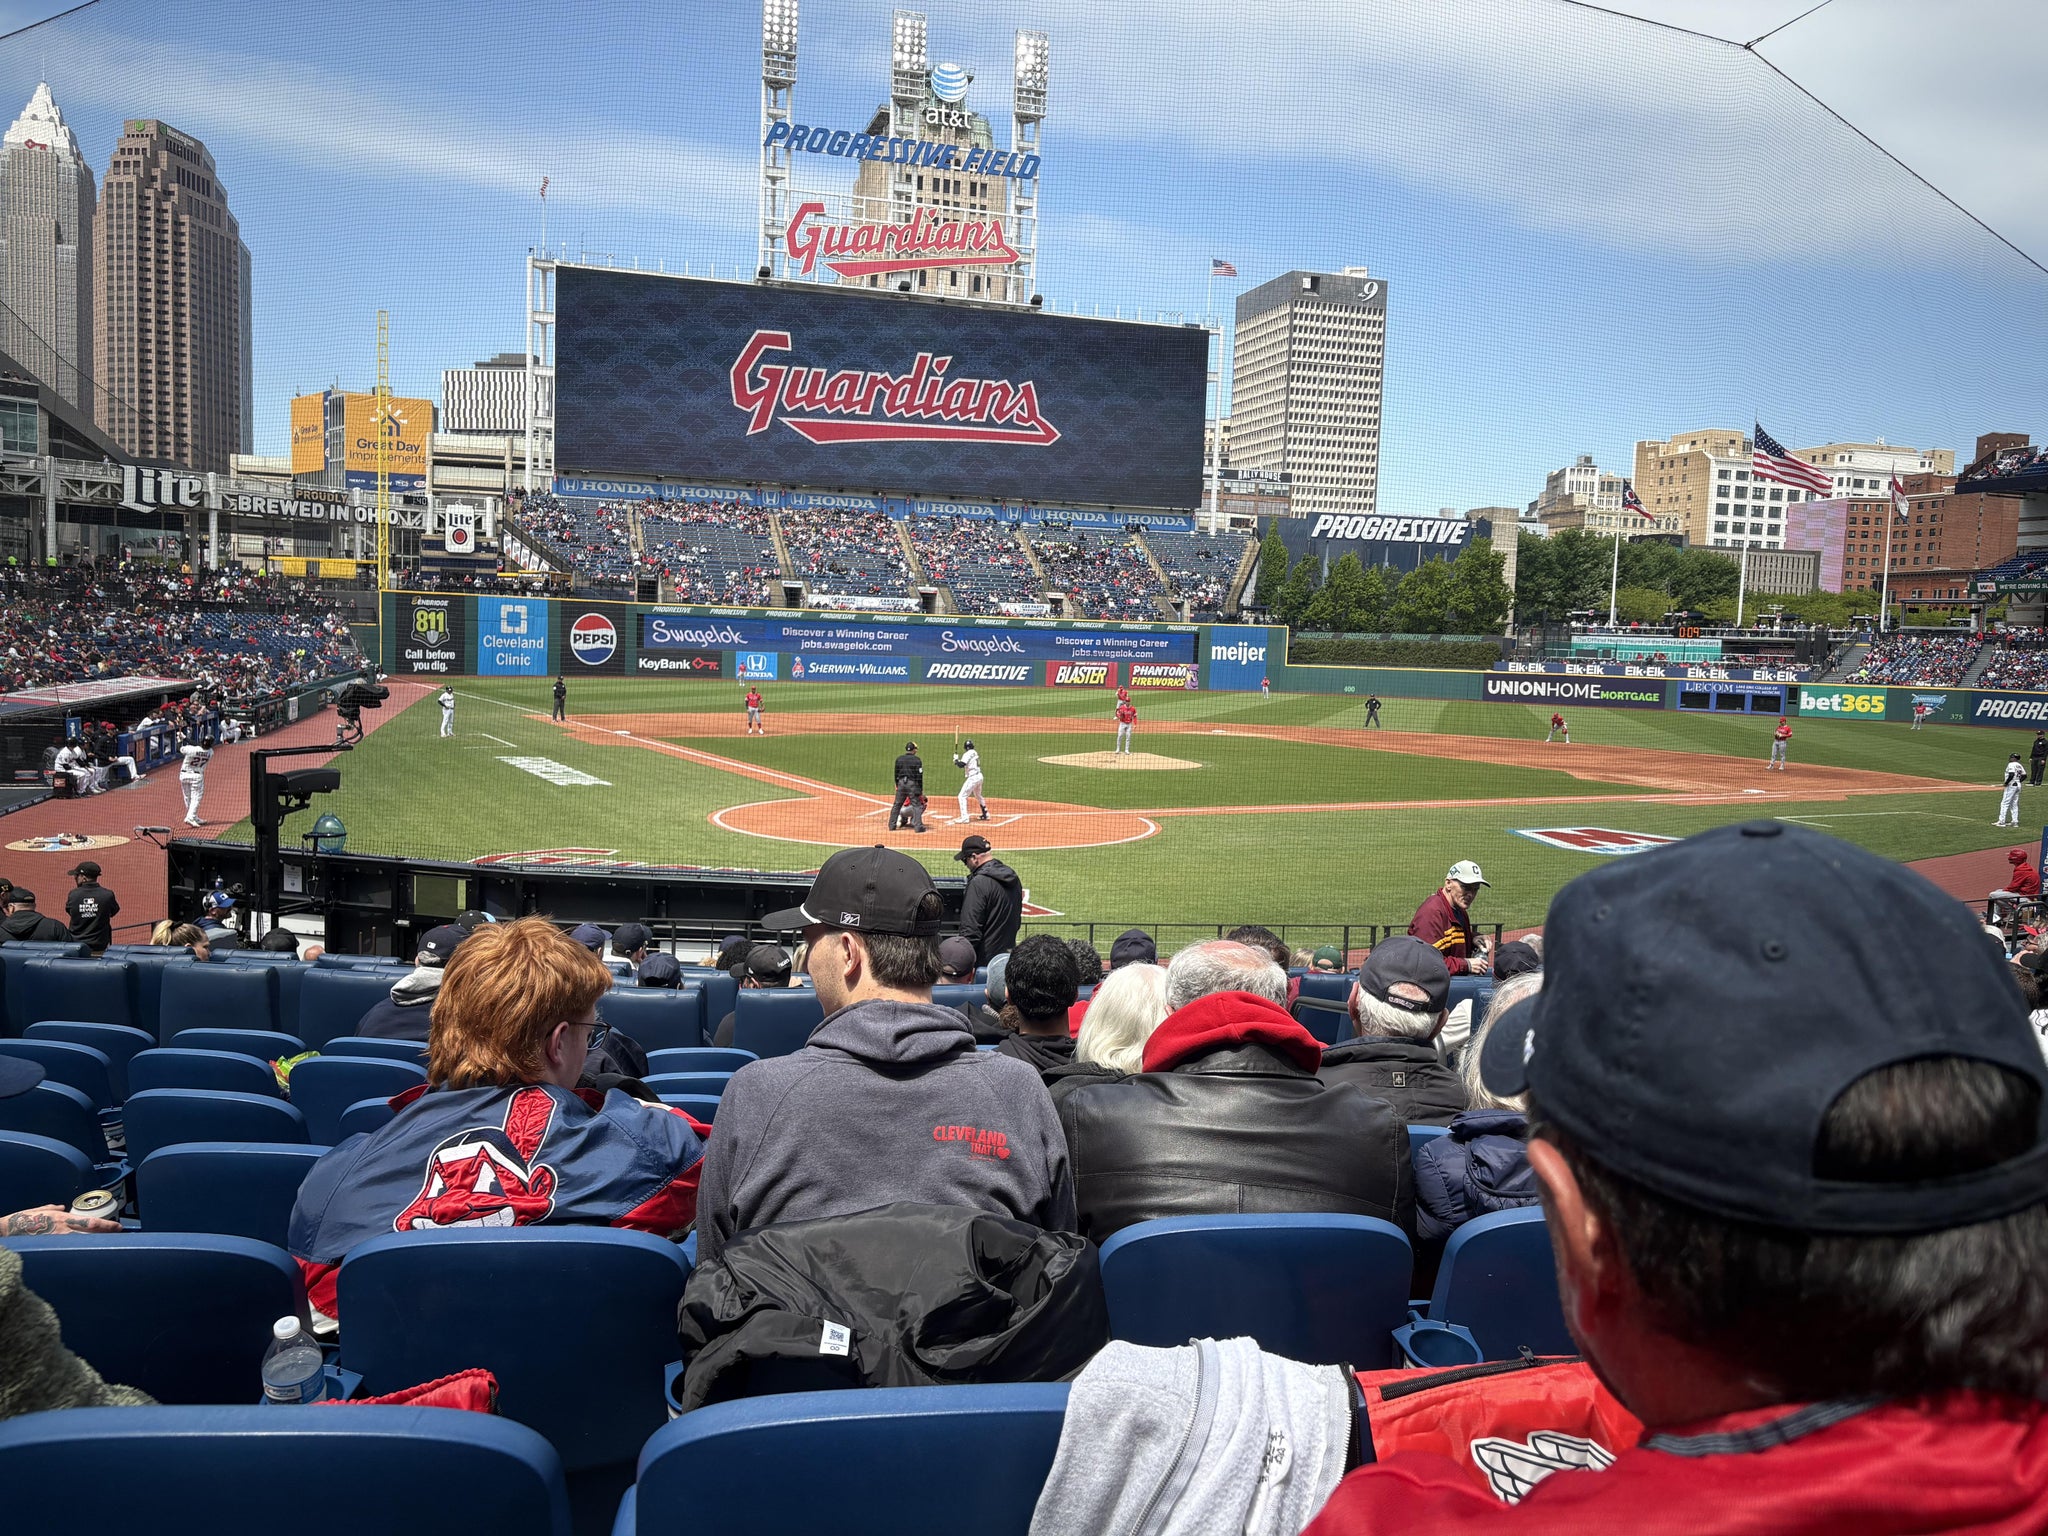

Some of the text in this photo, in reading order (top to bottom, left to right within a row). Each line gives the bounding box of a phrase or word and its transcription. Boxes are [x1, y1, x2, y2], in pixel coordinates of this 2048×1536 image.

[926, 104, 972, 130] at&t
[763, 121, 1041, 180] PROGRESSIVE FIELD
[786, 202, 1021, 277] Guardians
[730, 329, 1062, 446] Guardians
[356, 438, 420, 454] Great Day
[118, 464, 203, 514] Lite
[581, 481, 656, 495] HONDA
[680, 487, 754, 501] HONDA
[295, 489, 349, 504] PROUDLY
[807, 495, 877, 509] HONDA
[238, 494, 325, 519] BREWED
[329, 504, 350, 522] IN
[931, 503, 996, 516] HONDA
[448, 513, 473, 527] Lite
[1045, 510, 1108, 523] HONDA
[1127, 515, 1188, 527] HONDA
[1310, 513, 1470, 545] PROGRESSIVE
[417, 599, 448, 607] ENBRIDGE
[652, 606, 692, 614] PROGRESSIVE
[709, 608, 748, 616] PROGRESSIVE
[765, 610, 804, 618] PROGRESSIVE
[415, 609, 446, 632] 811
[819, 613, 857, 621] PROGRESSIVE
[872, 614, 909, 622] PROGRESSIVE
[974, 618, 1010, 626] PROGRESSIVE
[1023, 620, 1058, 628] PROGRESSIVE
[1119, 623, 1154, 631] PROGRESSIVE
[652, 620, 748, 648] Swagelok
[782, 626, 909, 641] Discover a Winning Career
[1295, 632, 1336, 640] PROGRESSIVE
[1341, 632, 1383, 641] PROGRESSIVE
[1389, 633, 1432, 642] PROGRESSIVE
[1439, 634, 1484, 642] PROGRESSIVE
[1679, 626, 1700, 638] 0:09
[483, 635, 544, 649] Cleveland
[573, 634, 614, 645] PEPSI
[800, 639, 893, 652] jobs.swagelok.com
[941, 630, 1025, 657] Swagelok
[1055, 636, 1169, 649] Discover a Winning Career
[405, 648, 456, 660] Call before
[496, 653, 531, 666] Clinic
[1071, 648, 1154, 659] jobs.swagelok.com
[1211, 642, 1266, 666] meijer
[413, 660, 448, 673] you dig.
[639, 657, 691, 671] KeyBank
[808, 661, 908, 676] SHERWIN-WILLIAMS.
[926, 663, 1031, 681] PROGRESSIVE
[1055, 665, 1108, 684] BLASTER
[1132, 665, 1187, 677] PHANTOM
[1131, 676, 1186, 687] FIREWORKS
[1344, 685, 1356, 693] 400
[1601, 691, 1660, 702] MORTGAGE
[1800, 691, 1885, 713] bet365
[933, 1125, 1007, 1147] CLEVELAND
[970, 1142, 992, 1156] THAT
